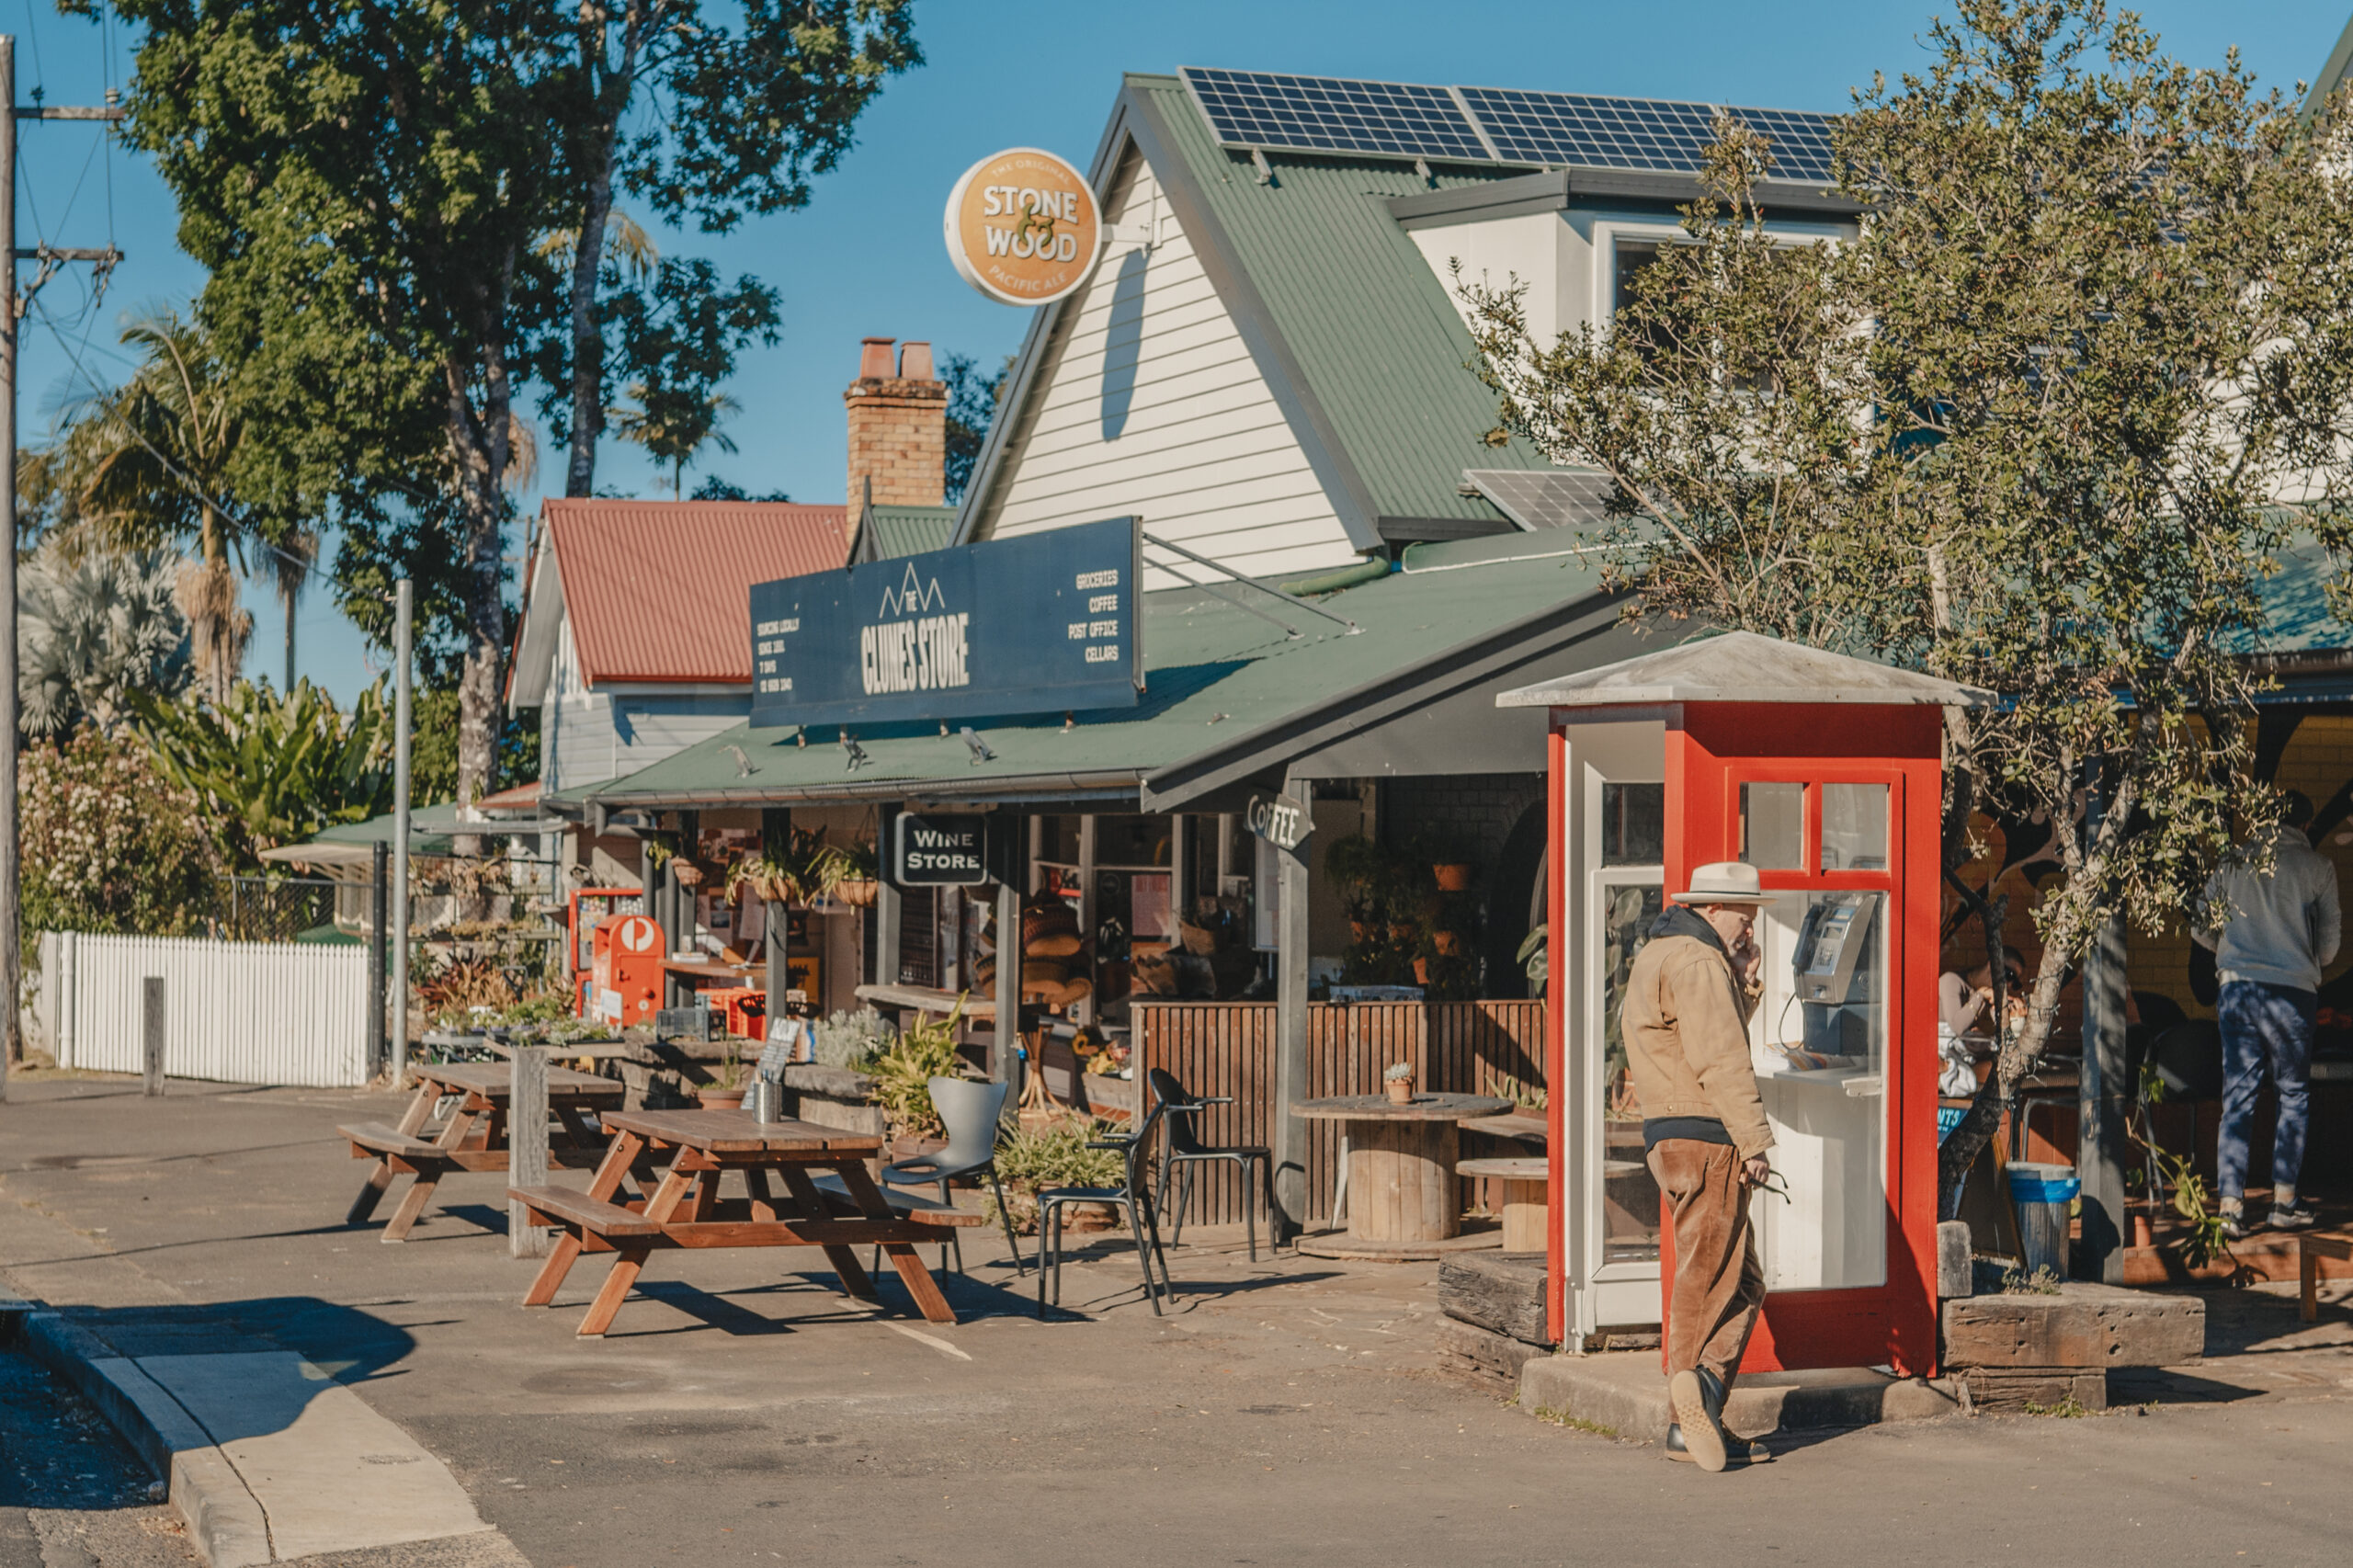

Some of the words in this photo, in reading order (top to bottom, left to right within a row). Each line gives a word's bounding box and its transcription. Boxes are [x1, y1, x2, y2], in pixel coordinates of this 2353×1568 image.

[992, 164, 1014, 177] THE
[1016, 159, 1070, 185] ORIGINAL
[983, 186, 1078, 224] STONE
[1017, 203, 1054, 247] &
[984, 225, 1077, 262] WOOD
[989, 264, 1040, 292] PACIFIC
[1044, 272, 1068, 291] ALE
[1075, 569, 1119, 590] GROCERIES
[905, 590, 917, 612] THE
[1088, 594, 1119, 613] COFFEE
[1068, 622, 1087, 640] POST
[1089, 619, 1119, 638] OFFICE
[860, 619, 917, 696] CLUNES
[917, 612, 970, 690] STORE
[1085, 645, 1119, 663] CELLARS
[1247, 794, 1300, 846] COFFEE
[913, 830, 973, 847] WINE
[907, 852, 981, 869] STORE
